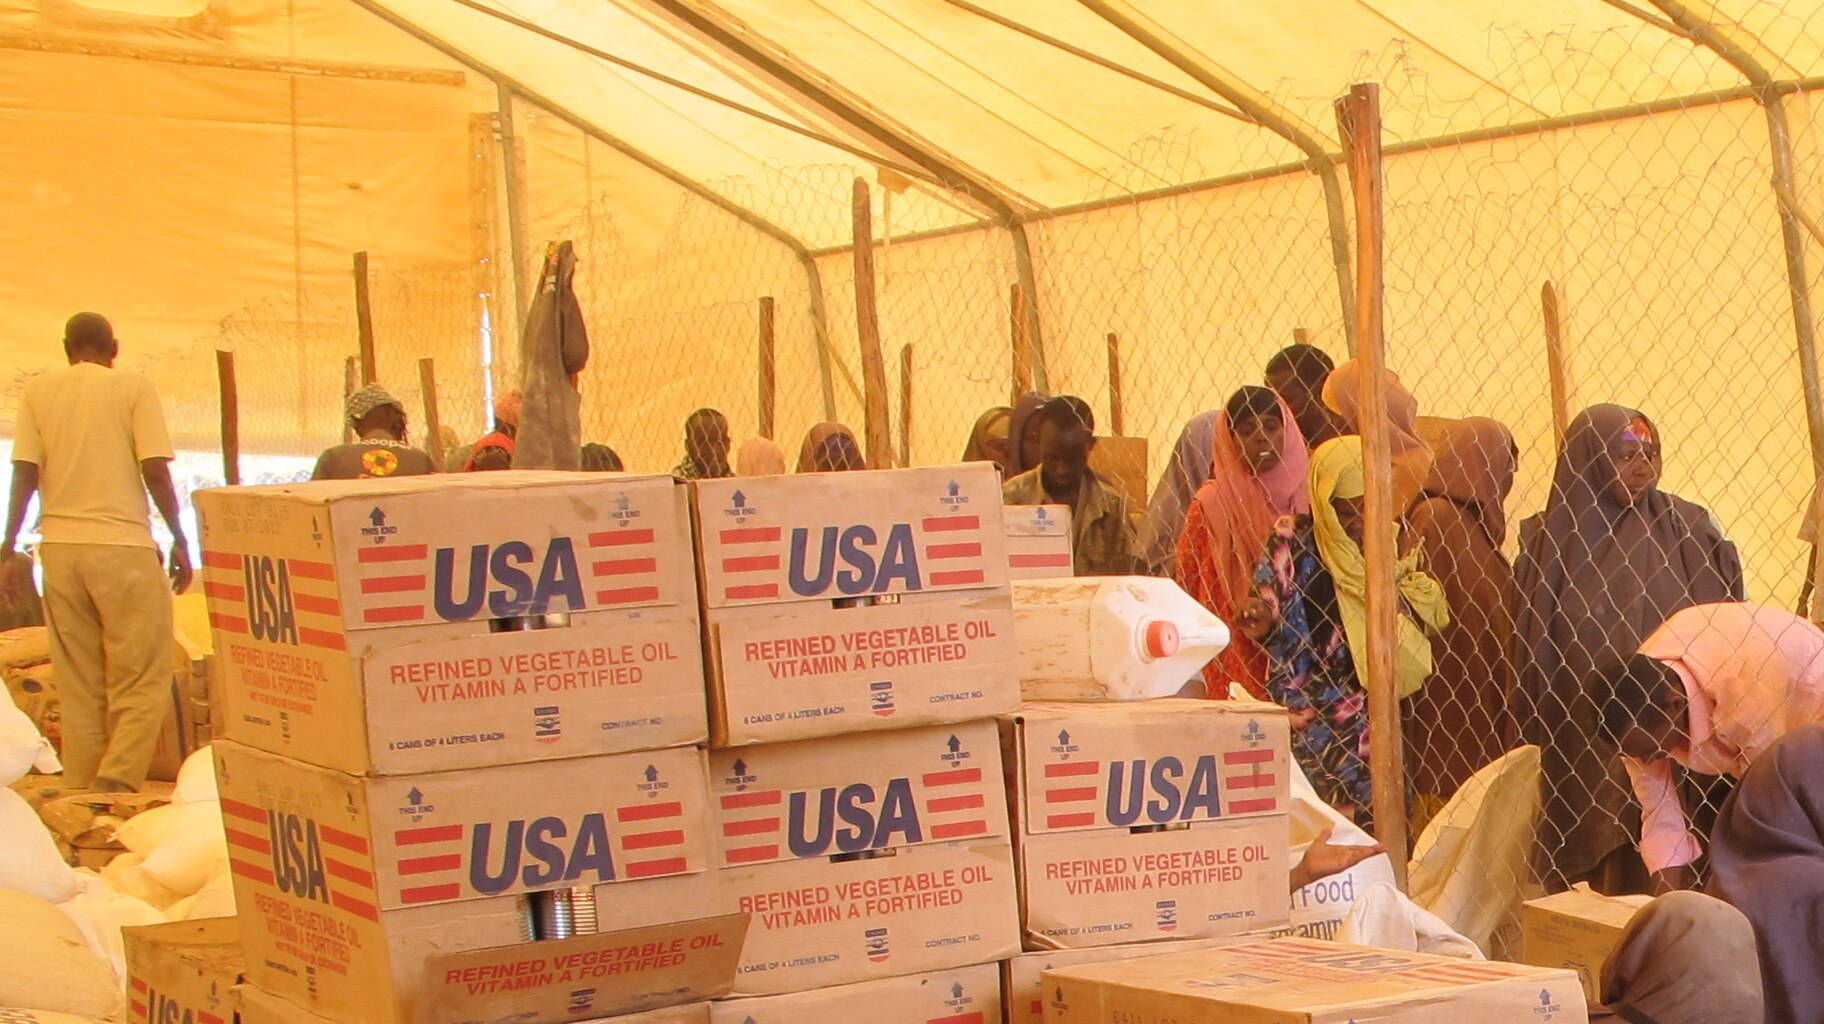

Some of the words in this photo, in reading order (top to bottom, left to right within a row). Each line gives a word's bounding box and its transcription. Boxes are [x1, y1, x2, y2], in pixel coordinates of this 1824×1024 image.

[434, 536, 586, 622] USA
[788, 524, 922, 596] USA
[243, 554, 299, 647] USA
[745, 634, 835, 662] REFINED
[841, 624, 958, 651] VEGETABLE
[964, 620, 996, 640] OIL
[768, 657, 848, 679] VITAMIN
[853, 656, 866, 671] A
[871, 643, 966, 669] FORTIFIED
[390, 658, 492, 684] REFINED
[500, 646, 633, 674] VEGETABLE
[642, 642, 677, 661] OIL
[417, 679, 505, 703] VITAMIN
[513, 677, 527, 694] A
[534, 666, 643, 693] FORTIFIED
[1106, 755, 1222, 826] USA
[788, 778, 923, 859] USA
[267, 809, 331, 904] USA
[469, 813, 616, 895] USA
[1046, 858, 1127, 880] REFINED
[1132, 848, 1236, 872] VEGETABLE
[1242, 845, 1270, 862] OIL
[739, 886, 829, 914] REFINED
[836, 870, 955, 901] VEGETABLE
[961, 866, 993, 884] OIL
[1066, 874, 1136, 896] VITAMIN
[1141, 874, 1153, 889] A
[1158, 866, 1243, 888] FORTIFIED
[1301, 873, 1354, 907] Food
[762, 906, 841, 930] VITAMIN
[848, 906, 860, 919] A
[866, 889, 963, 915] FORTIFIED
[445, 959, 546, 984] REFINED
[553, 940, 684, 970] VEGETABLE
[690, 934, 723, 949] OIL
[925, 937, 966, 948] CONTRACT
[467, 974, 551, 996] VITAMIN
[559, 969, 573, 982] A
[579, 953, 686, 980] FORTIFIED
